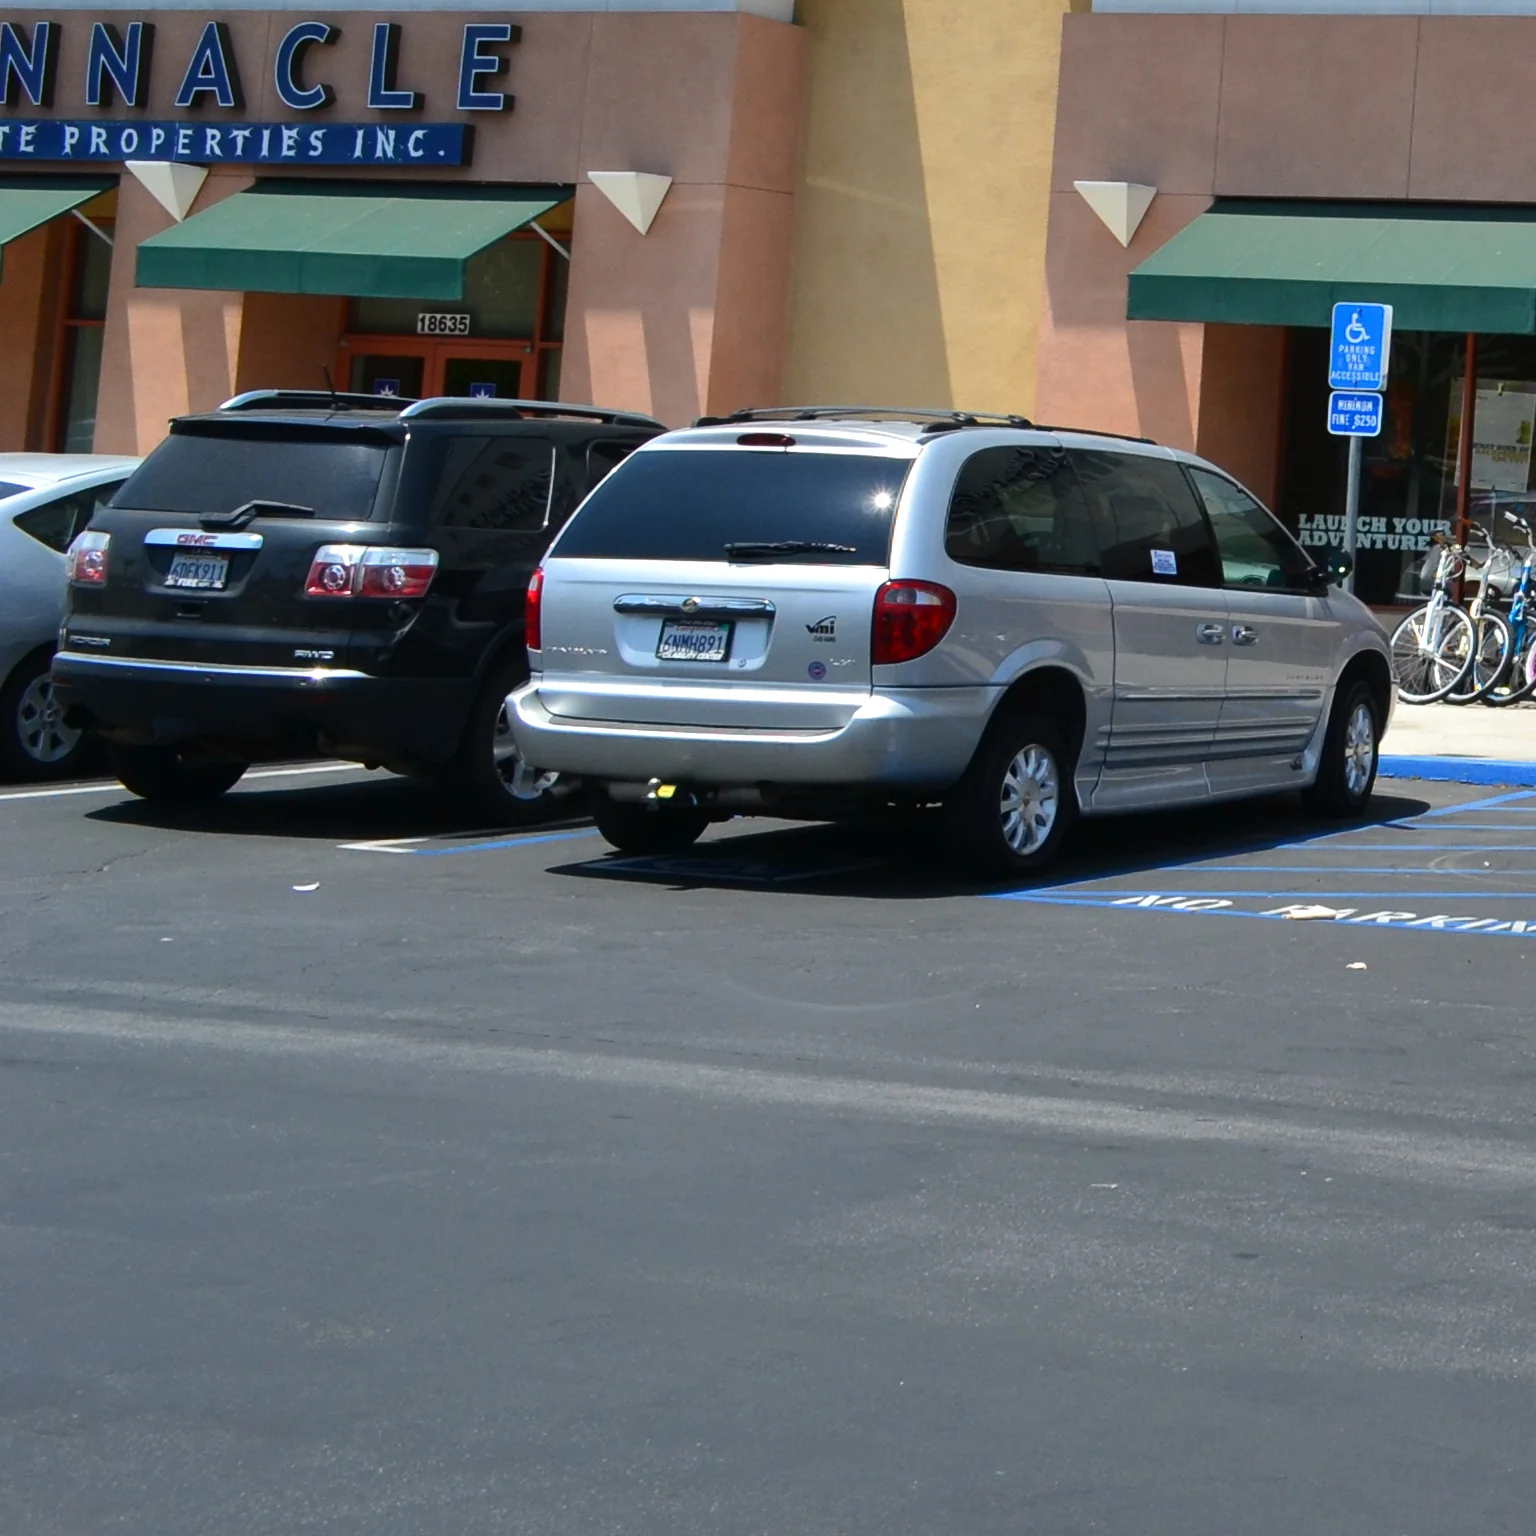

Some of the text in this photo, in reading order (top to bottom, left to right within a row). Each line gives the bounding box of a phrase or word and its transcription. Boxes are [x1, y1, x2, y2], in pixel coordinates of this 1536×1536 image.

[0, 21, 515, 112] NNACLE
[61, 124, 327, 158] PROPERTIES
[352, 125, 446, 158] INC.
[419, 314, 469, 333] 18635
[1338, 344, 1375, 355] PARKING
[1345, 353, 1367, 363] ONLY
[1331, 370, 1380, 381] ACCESSIBLE
[1338, 399, 1373, 412] MINIMUM
[1331, 413, 1349, 425] FINE
[1392, 517, 1452, 536] YOUR
[177, 534, 219, 546] GMC
[1298, 530, 1431, 551] ADVNTURE
[663, 634, 723, 653] 6NMH891
[1110, 895, 1233, 911] NO
